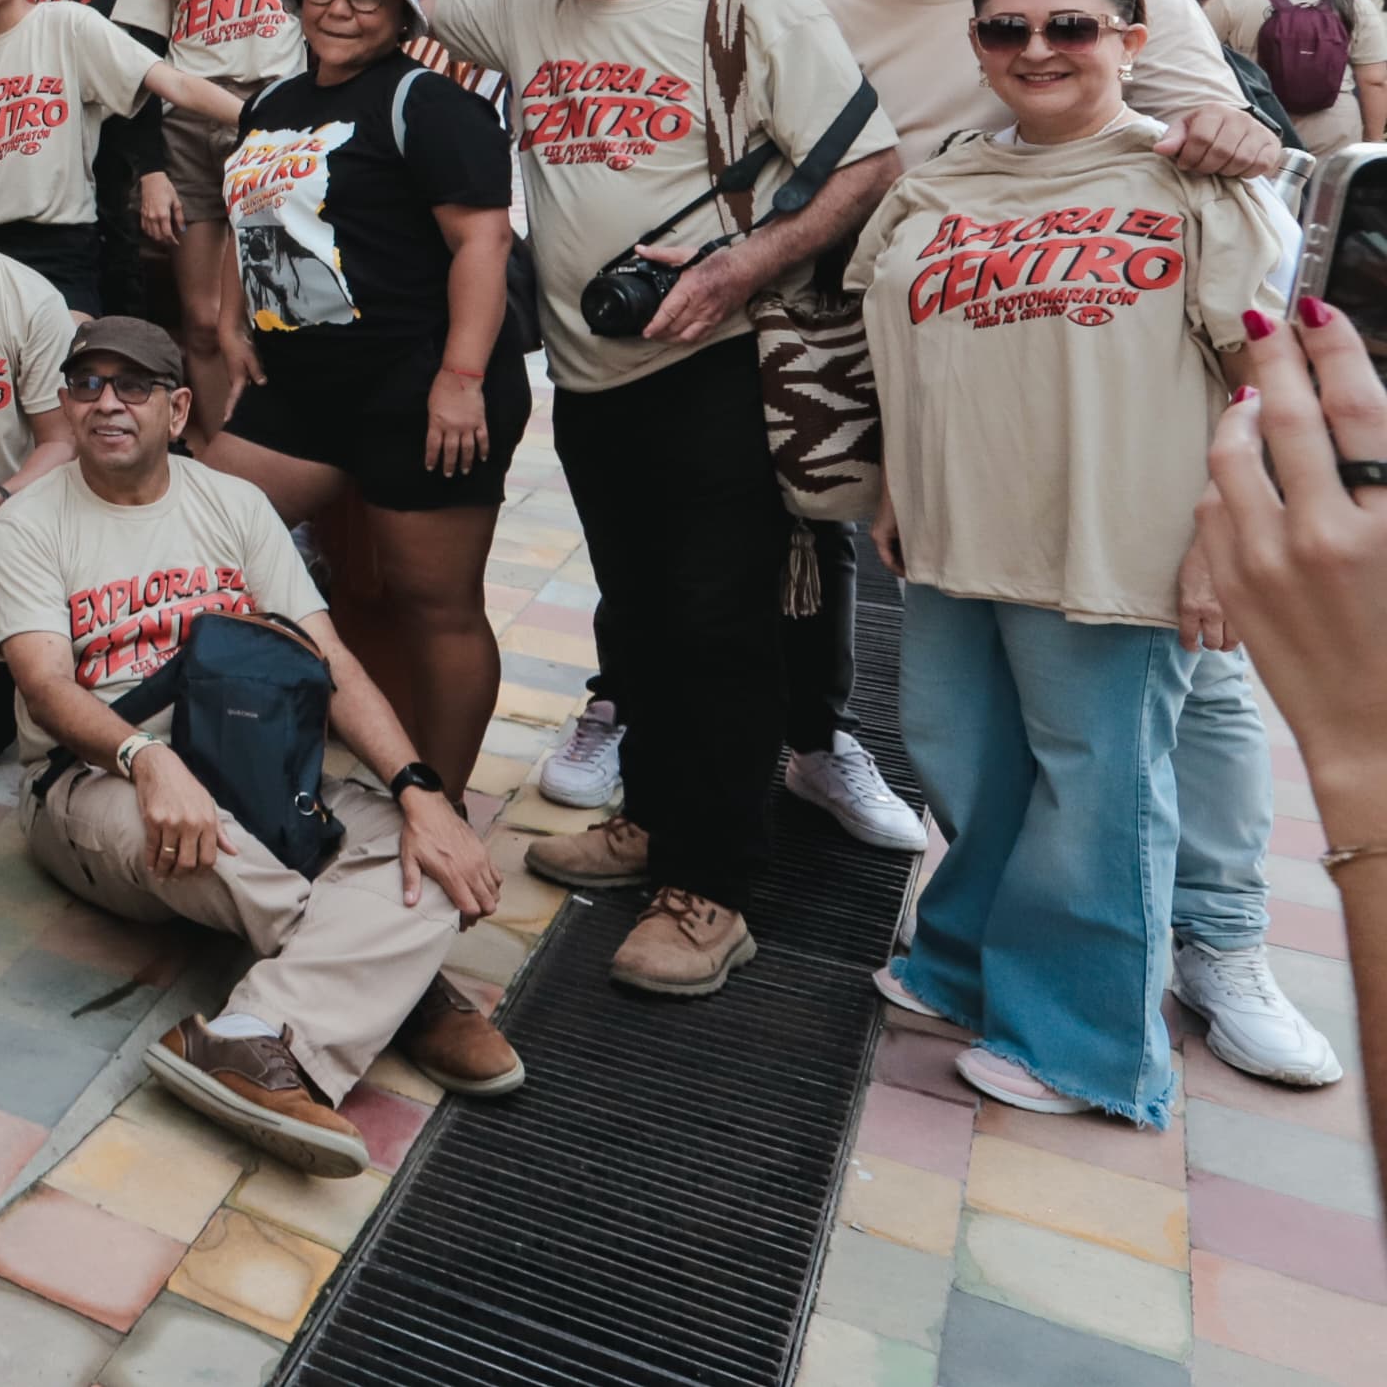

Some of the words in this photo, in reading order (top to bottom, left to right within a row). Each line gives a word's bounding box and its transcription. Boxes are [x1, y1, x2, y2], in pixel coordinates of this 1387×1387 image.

[36, 75, 66, 94] EL
[521, 60, 647, 99] EXPLORA
[645, 73, 693, 101] EL
[518, 96, 694, 152] CENTRO
[916, 207, 1116, 261] EXPLORA
[1115, 208, 1185, 242] EL
[908, 236, 1184, 326] CENTRO
[962, 300, 993, 322] XIX
[993, 286, 1141, 314] FOTOMARATÓN
[973, 315, 1001, 330] MIRA
[1001, 312, 1017, 325] AL
[1018, 304, 1068, 322] CENTRO
[68, 566, 209, 644] EXPLORA
[214, 567, 247, 591] EL
